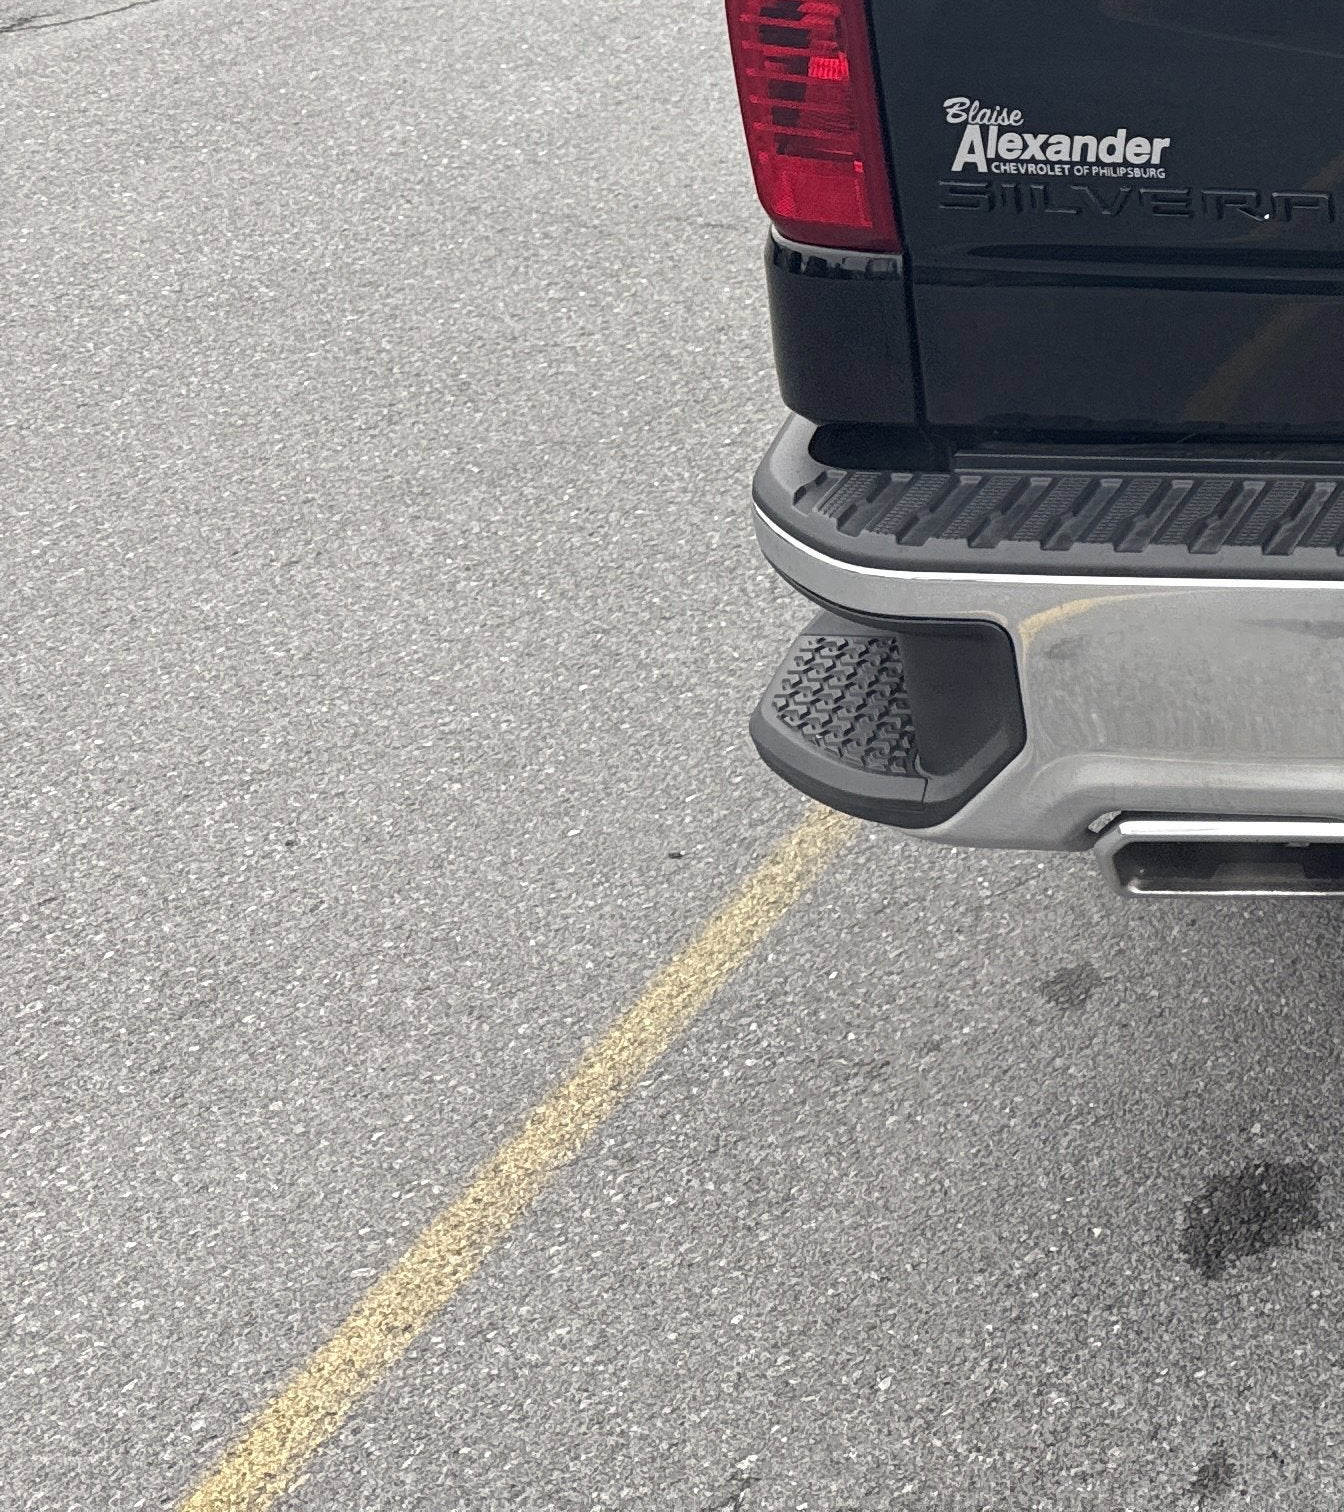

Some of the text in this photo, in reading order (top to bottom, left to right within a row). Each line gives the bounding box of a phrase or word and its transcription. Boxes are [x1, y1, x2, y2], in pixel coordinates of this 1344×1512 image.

[942, 96, 1025, 127] Blaise
[951, 124, 1171, 172] Alexander
[990, 161, 1167, 179] CHEVROLET OF PHILIPSBURG
